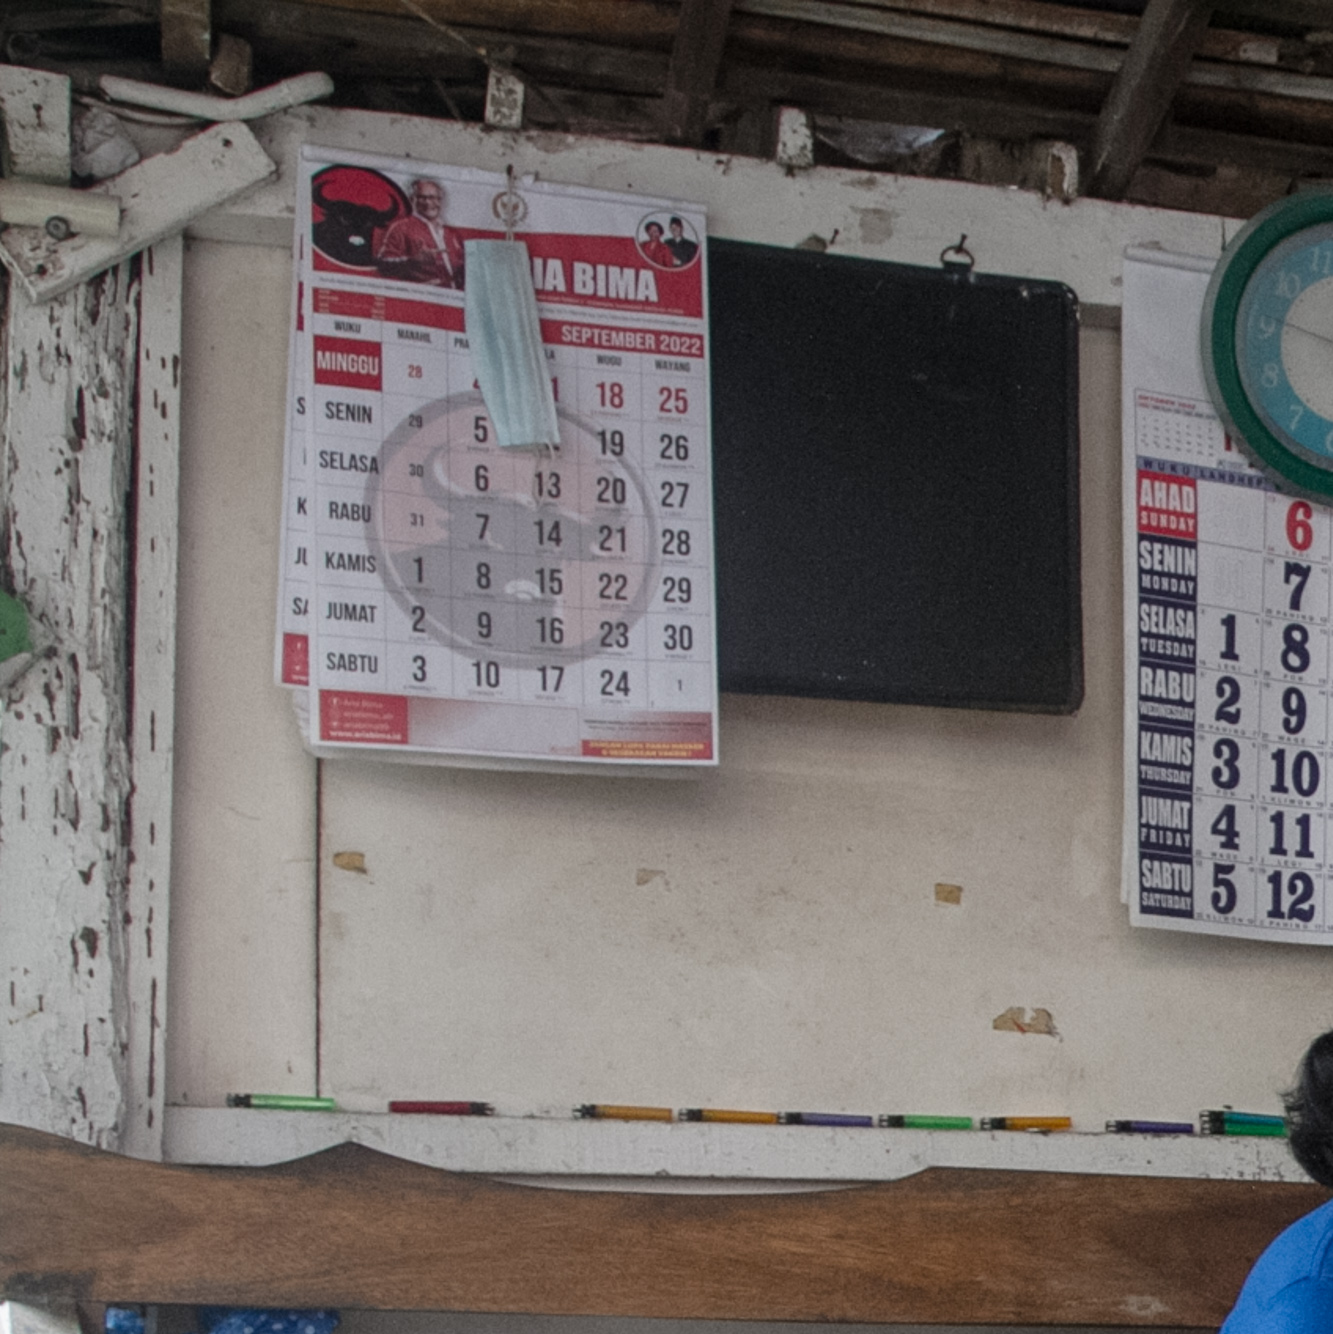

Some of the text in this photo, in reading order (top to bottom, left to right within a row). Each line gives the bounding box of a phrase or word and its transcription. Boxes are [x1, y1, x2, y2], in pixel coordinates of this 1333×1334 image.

[533, 257, 659, 303] IA BIMA
[1310, 247, 1332, 274] 11
[1276, 272, 1299, 299] 10
[334, 321, 361, 334] WUKU
[397, 329, 431, 344] MANAHIL
[597, 354, 622, 366] WUGU
[655, 359, 690, 373] WAYANG
[561, 325, 701, 354] SEPTEMBER 2022
[1260, 315, 1275, 339] 9
[316, 350, 688, 414] MINGGU 28 1 18 25
[1262, 363, 1279, 389] 8
[325, 400, 373, 424] SENIN
[408, 414, 423, 429] 29
[473, 416, 488, 443] 5
[596, 430, 625, 457] 19
[659, 433, 689, 461] 26
[1289, 404, 1304, 431] 7
[319, 451, 689, 509] SELASA 30 6 13 20 27
[1143, 459, 1191, 476] WUKU
[328, 501, 372, 523] RABU
[409, 512, 425, 527] 31
[475, 514, 490, 540] 7
[533, 520, 562, 547] 14
[598, 525, 626, 553] 21
[661, 529, 691, 556] 28
[1140, 479, 1195, 513] AHAD
[1285, 500, 1313, 552] 6
[1140, 510, 1195, 533] SUNDAY
[325, 552, 377, 574] KAMIS
[413, 557, 424, 584] 1
[476, 563, 491, 589] 8
[535, 568, 563, 595] 15
[598, 573, 628, 600] 22
[662, 577, 692, 603] 29
[1140, 541, 1196, 576] SENIN
[1284, 561, 1312, 611] 7
[1141, 573, 1195, 595] MONDAY
[325, 602, 378, 624] JUMAT
[411, 606, 426, 633] 2
[477, 612, 492, 638] 9
[535, 617, 564, 645] 16
[600, 621, 629, 648] 23
[663, 624, 693, 652] 30
[1140, 603, 1195, 640] SELASA
[1220, 613, 1239, 662] 1
[1280, 623, 1310, 674] 8
[1140, 637, 1195, 659] TUESDAY
[326, 652, 379, 674] SABTU
[412, 655, 427, 682] 3
[472, 660, 500, 688] 10
[536, 666, 564, 692] 17
[600, 670, 630, 697] 24
[677, 680, 683, 691] 1
[1140, 666, 1195, 703] RABU
[1214, 675, 1242, 725] 2
[1281, 686, 1308, 735] 9
[1140, 701, 1195, 720] WEDNESDAY
[1140, 731, 1193, 766] KAMIS
[1211, 738, 1240, 790] 3
[1270, 747, 1320, 798] 10
[1140, 765, 1192, 785] THURSDAY
[1140, 795, 1191, 830] JUMAT
[1211, 804, 1240, 851] 4
[1269, 810, 1314, 859] 11
[1141, 828, 1191, 848] FRIDAY
[1141, 859, 1192, 893] SABTU
[1211, 862, 1237, 915] 5
[1267, 869, 1315, 923] 12
[1141, 891, 1192, 911] SATURDAY
